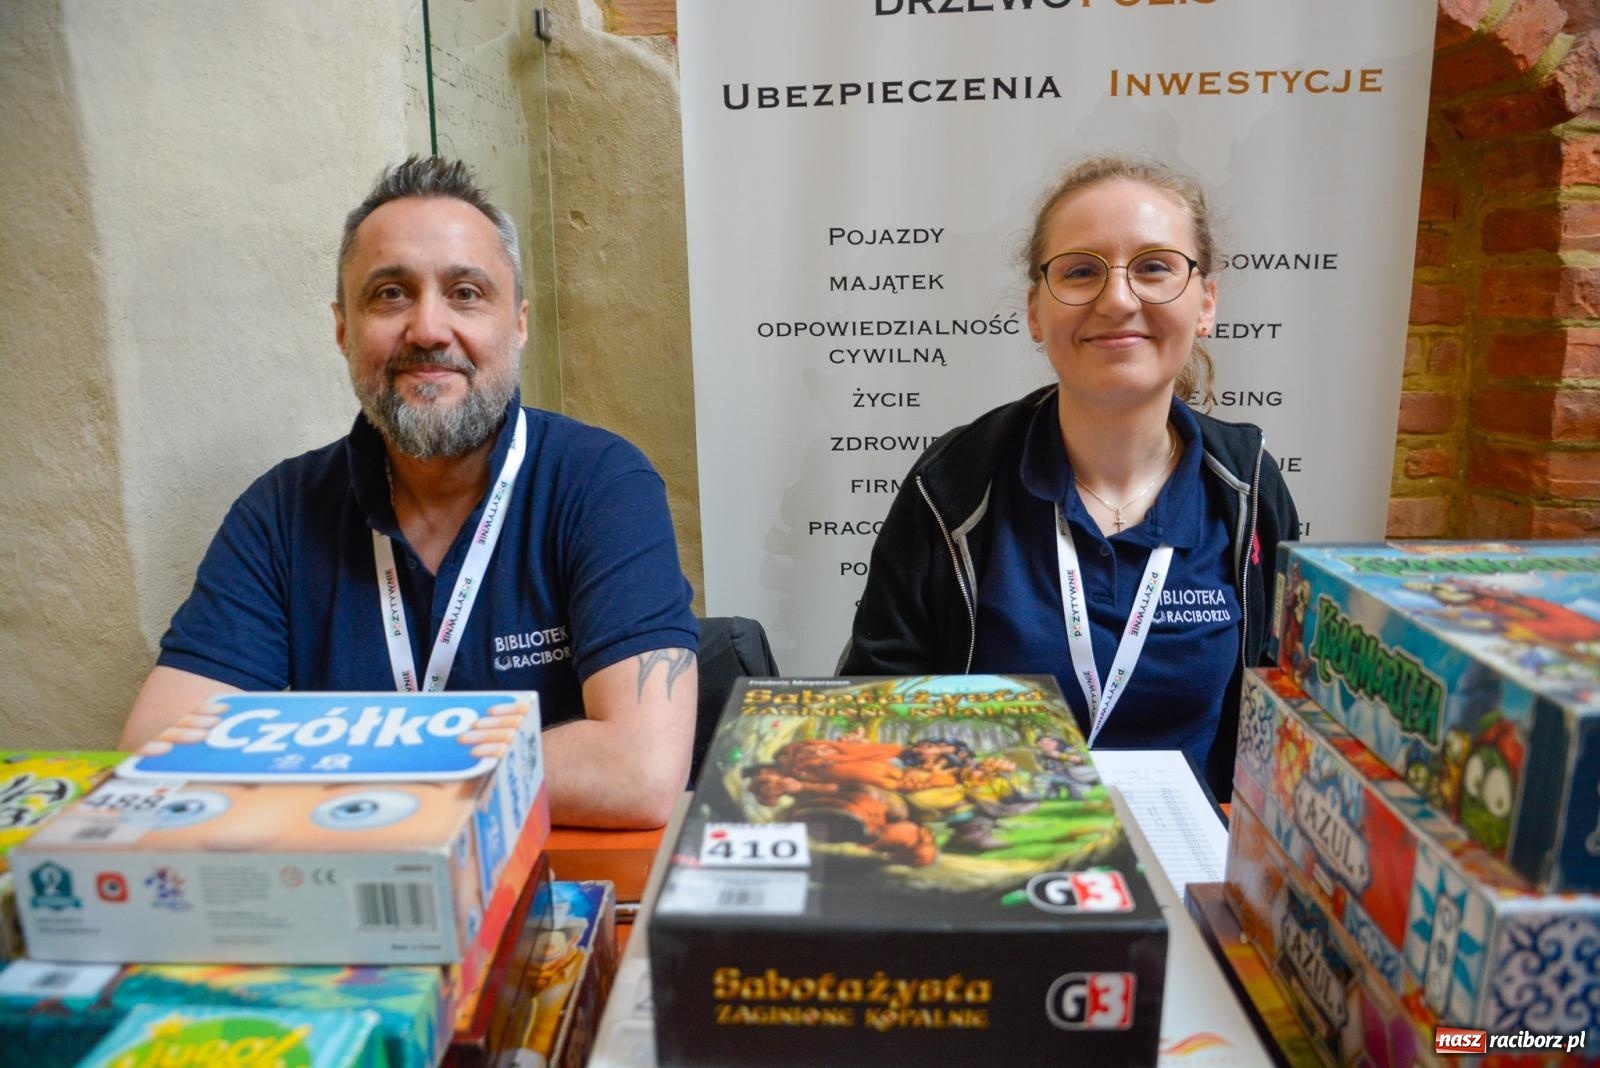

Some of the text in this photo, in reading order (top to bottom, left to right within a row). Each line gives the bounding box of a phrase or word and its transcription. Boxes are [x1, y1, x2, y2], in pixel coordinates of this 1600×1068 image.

[1110, 68, 1383, 97] INWESTYCJE
[723, 76, 1062, 110] UBEZPIECZENIA
[829, 227, 945, 246] POJAZDY
[830, 274, 945, 294] MAJĄTEK
[757, 312, 1020, 338] ODPOWIEDZIALNOŚĆ
[1198, 323, 1282, 339] EDYT
[829, 348, 948, 367] CYWILNĄ
[852, 388, 921, 408] ŻYCIE
[1166, 609, 1231, 623] RACIBORZU
[205, 705, 479, 753] Czółko
[1302, 797, 1354, 875] AZUL
[707, 839, 799, 859] 410
[713, 966, 992, 1011] Sabotażysta
